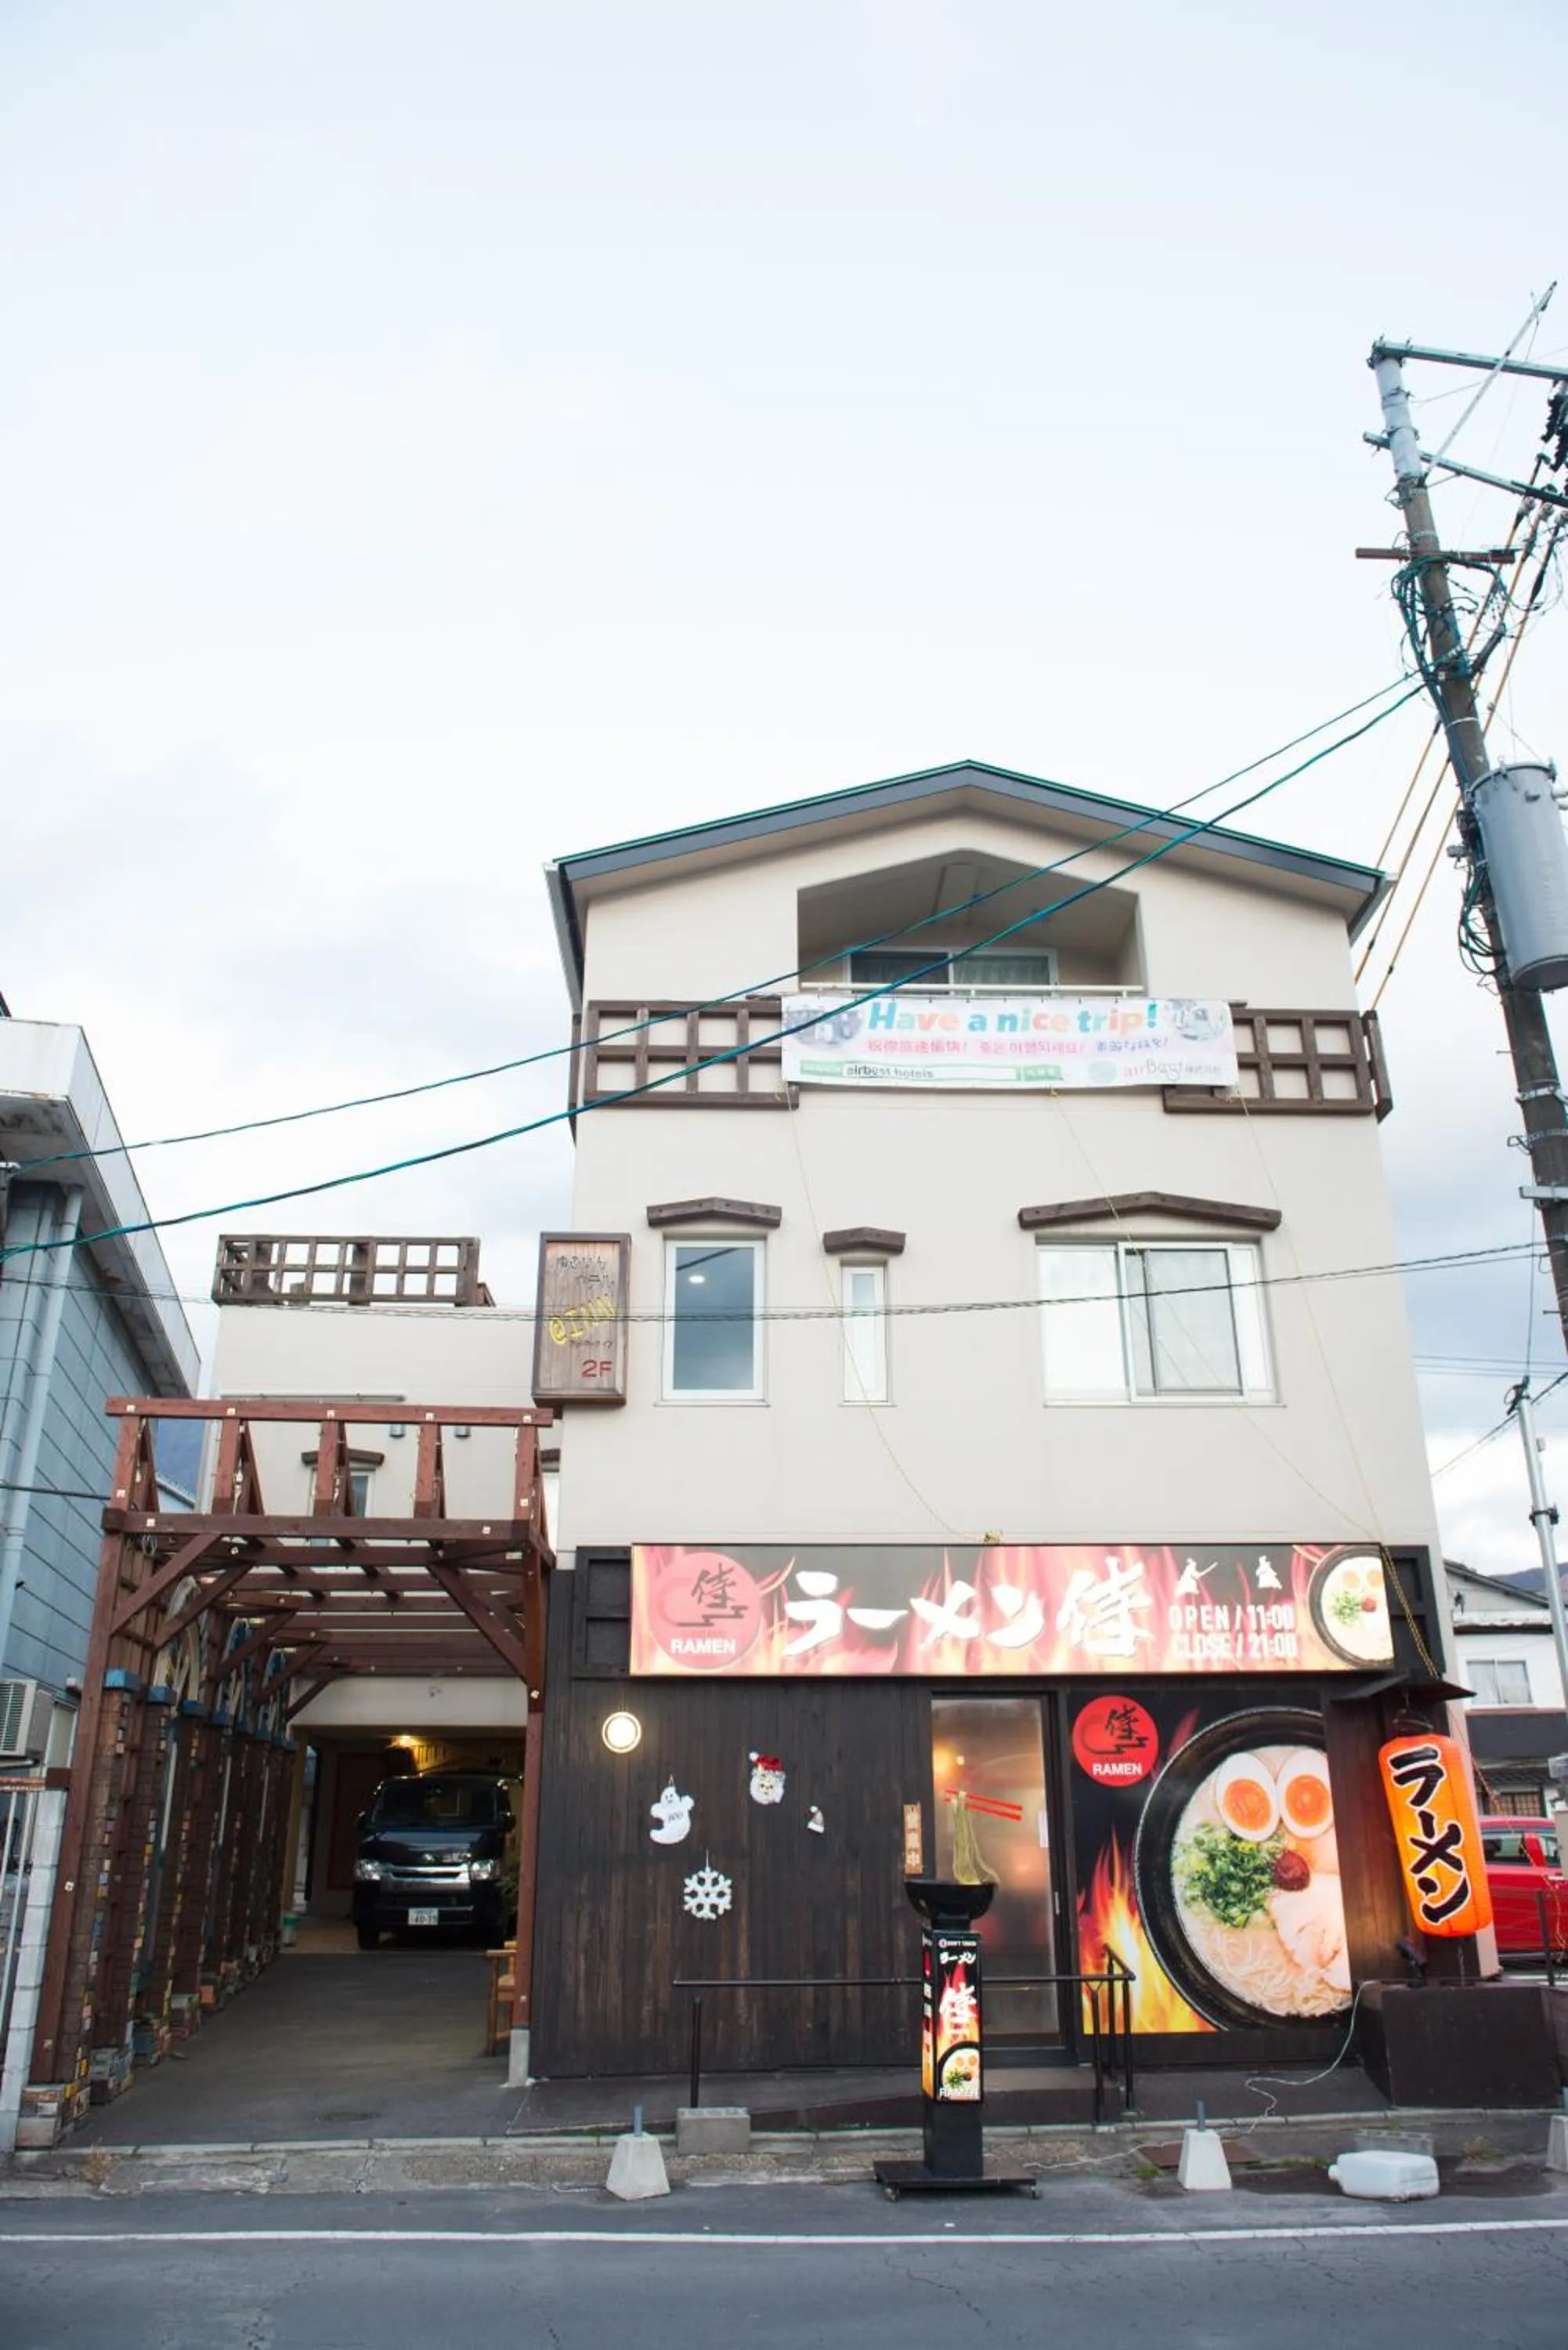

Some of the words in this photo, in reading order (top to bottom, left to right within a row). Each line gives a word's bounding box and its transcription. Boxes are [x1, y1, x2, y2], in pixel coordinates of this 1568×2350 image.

[868, 1002, 960, 1032] Have
[967, 1013, 988, 1032] a
[996, 1007, 1071, 1032] nice
[1077, 1003, 1158, 1035] trip!
[581, 1359, 613, 1378] 2F
[1169, 1604, 1230, 1631] OPEN
[1247, 1604, 1295, 1630] 11:00
[670, 1638, 736, 1656] RAMEN
[1172, 1632, 1232, 1658] CLOSE
[1248, 1632, 1299, 1658] 21:00
[1092, 1762, 1143, 1777] RAMEN
[1388, 1744, 1471, 1925] ラーメン
[939, 1950, 977, 1965] ラーメン
